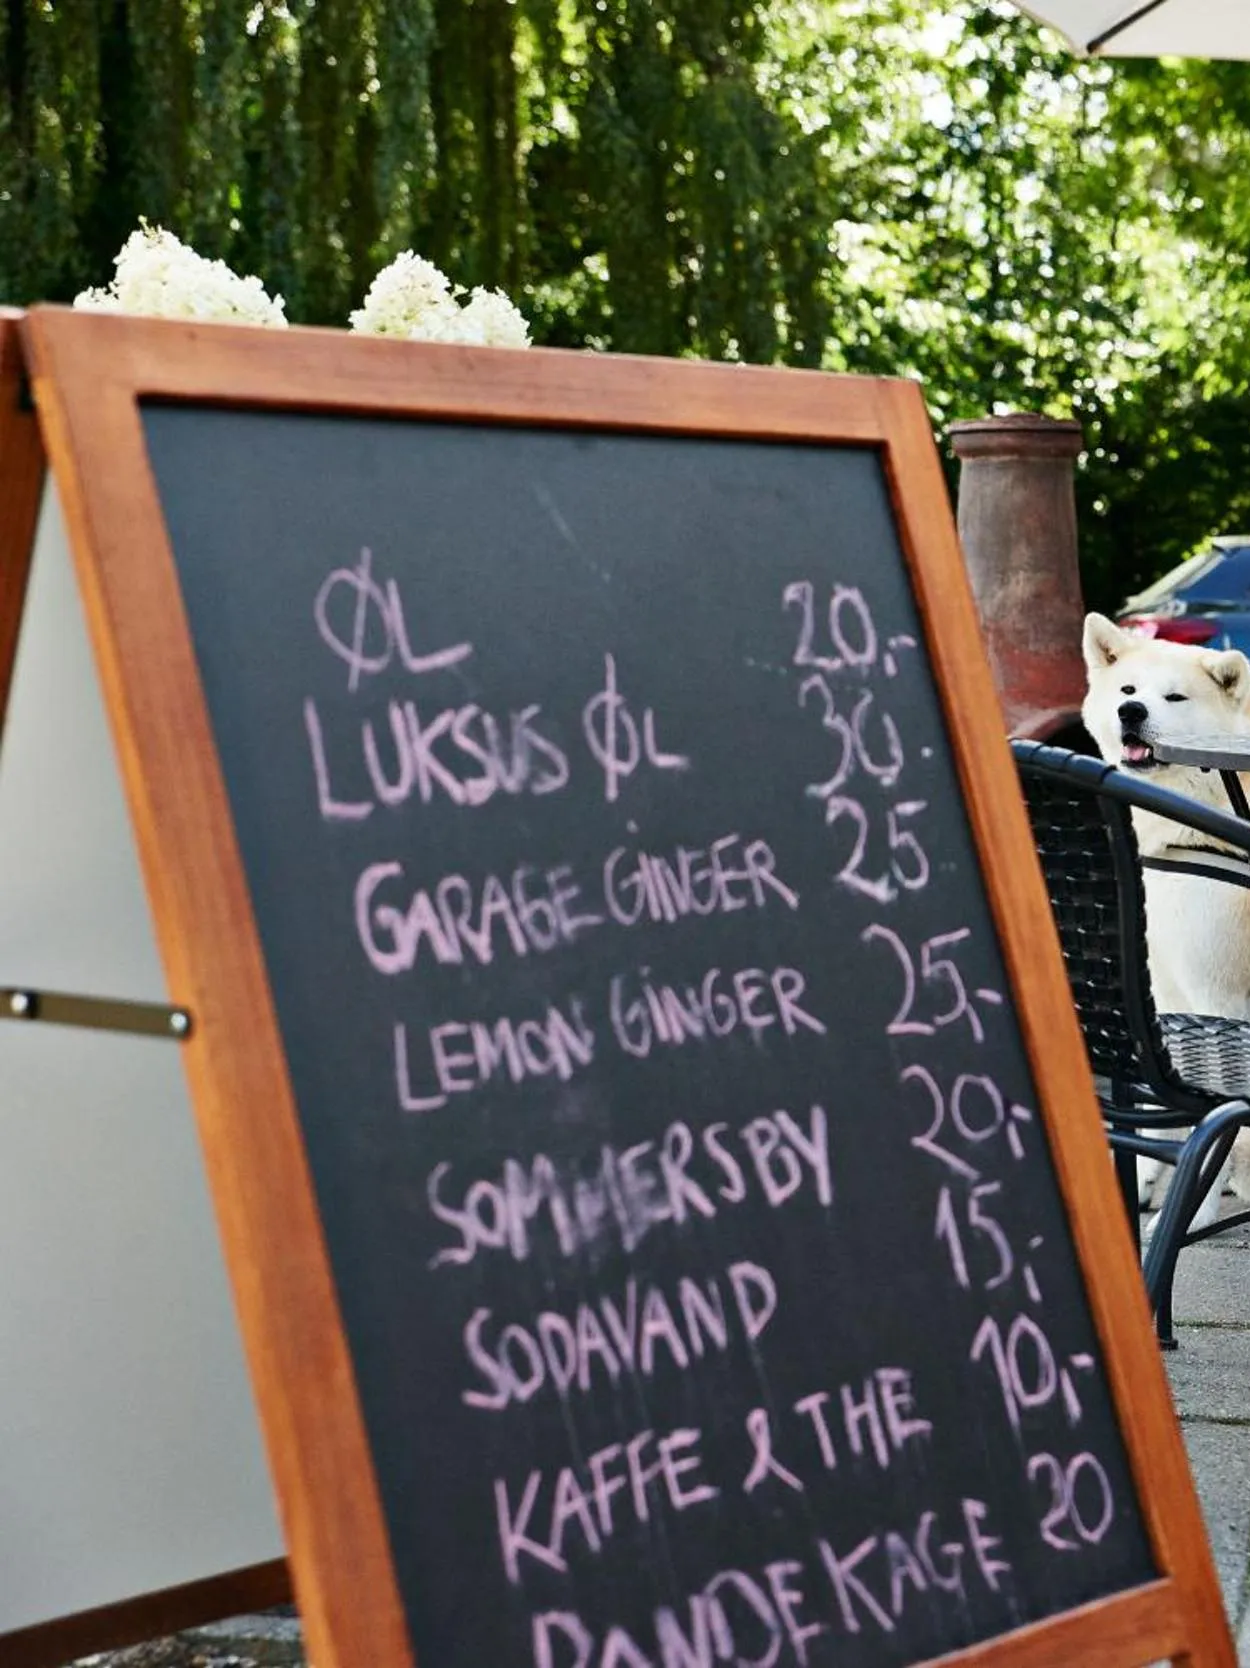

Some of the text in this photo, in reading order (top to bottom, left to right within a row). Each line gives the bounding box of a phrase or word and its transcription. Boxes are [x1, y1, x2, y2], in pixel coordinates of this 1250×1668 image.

[315, 547, 473, 692] ØL
[304, 697, 569, 820] LUKSUS
[582, 652, 690, 801] ØL
[354, 860, 604, 976] GARAGE
[394, 994, 595, 1111] LEMON
[427, 1104, 833, 1270] SOMMERSBY
[463, 1261, 778, 1410] SODAVAND
[495, 1428, 719, 1584] KAFFE
[794, 1367, 932, 1470] THE
[1028, 1451, 1114, 1551] 20
